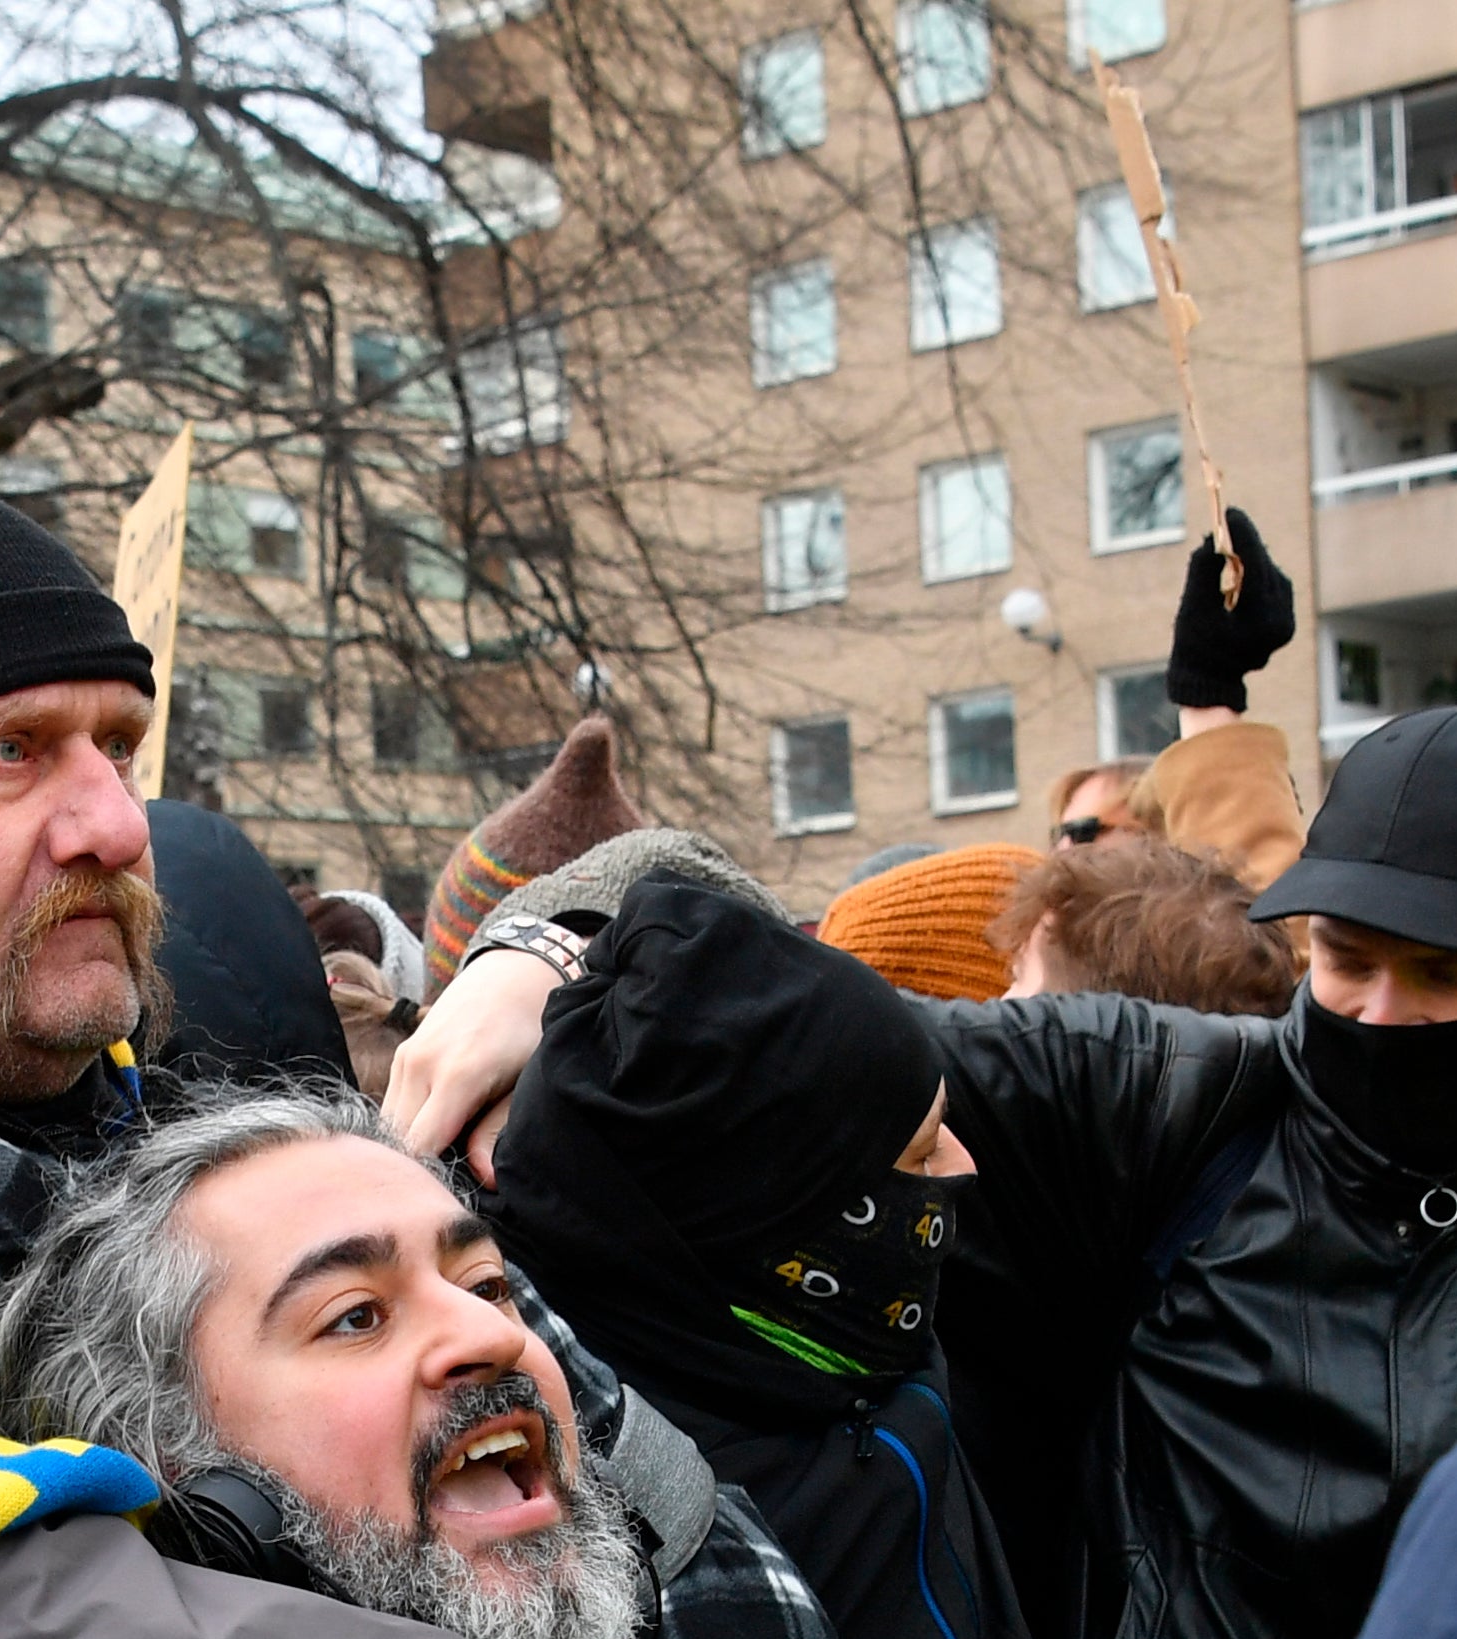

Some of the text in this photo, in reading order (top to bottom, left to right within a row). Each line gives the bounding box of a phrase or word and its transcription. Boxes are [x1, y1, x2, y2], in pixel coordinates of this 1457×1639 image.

[914, 1214, 944, 1248] 40
[775, 1260, 839, 1297] 40
[883, 1300, 922, 1330] 40
